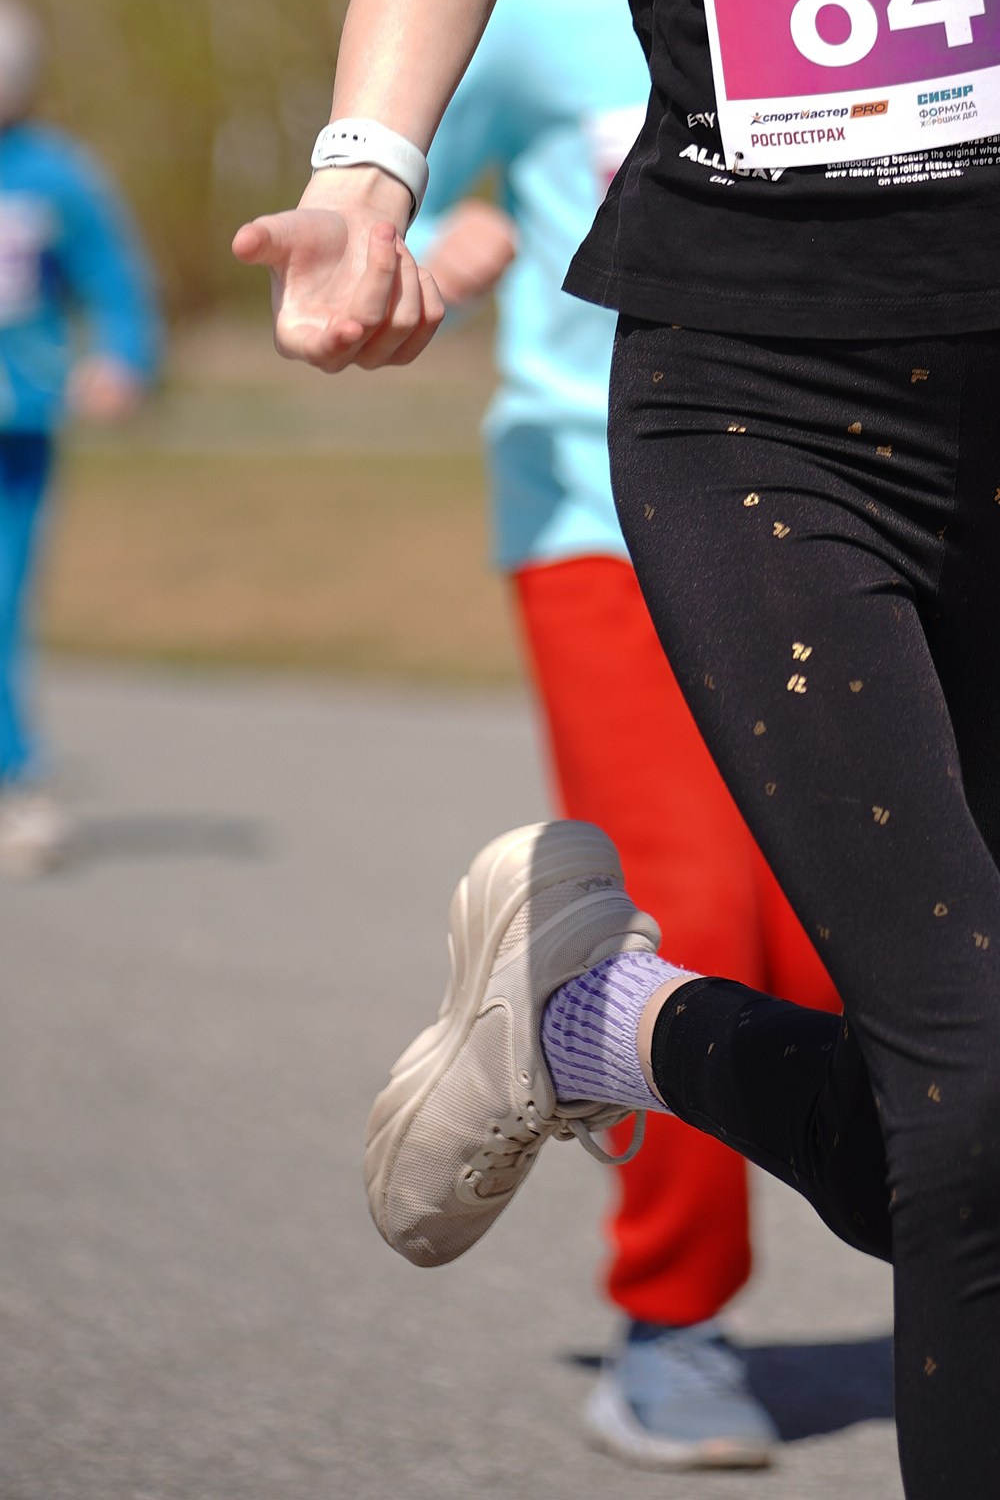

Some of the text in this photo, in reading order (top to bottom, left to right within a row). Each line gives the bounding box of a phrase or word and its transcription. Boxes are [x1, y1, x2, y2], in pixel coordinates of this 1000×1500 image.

[917, 84, 974, 105] СИБУР
[852, 102, 887, 118] PRO
[919, 100, 976, 119] ФОРМУЛА
[962, 110, 978, 121] ДЕЛ
[750, 127, 846, 148] РОСГОССТРАХ
[679, 143, 726, 172] ALL
[892, 152, 929, 165] because
[930, 149, 944, 160] the
[946, 146, 978, 159] original
[825, 169, 847, 179] were
[849, 166, 875, 178] taken
[876, 166, 898, 177] from
[899, 163, 923, 174] roller
[925, 161, 953, 172] skates
[954, 158, 970, 169] and
[972, 156, 993, 167] were
[878, 177, 891, 187] on
[893, 173, 929, 185] wooden
